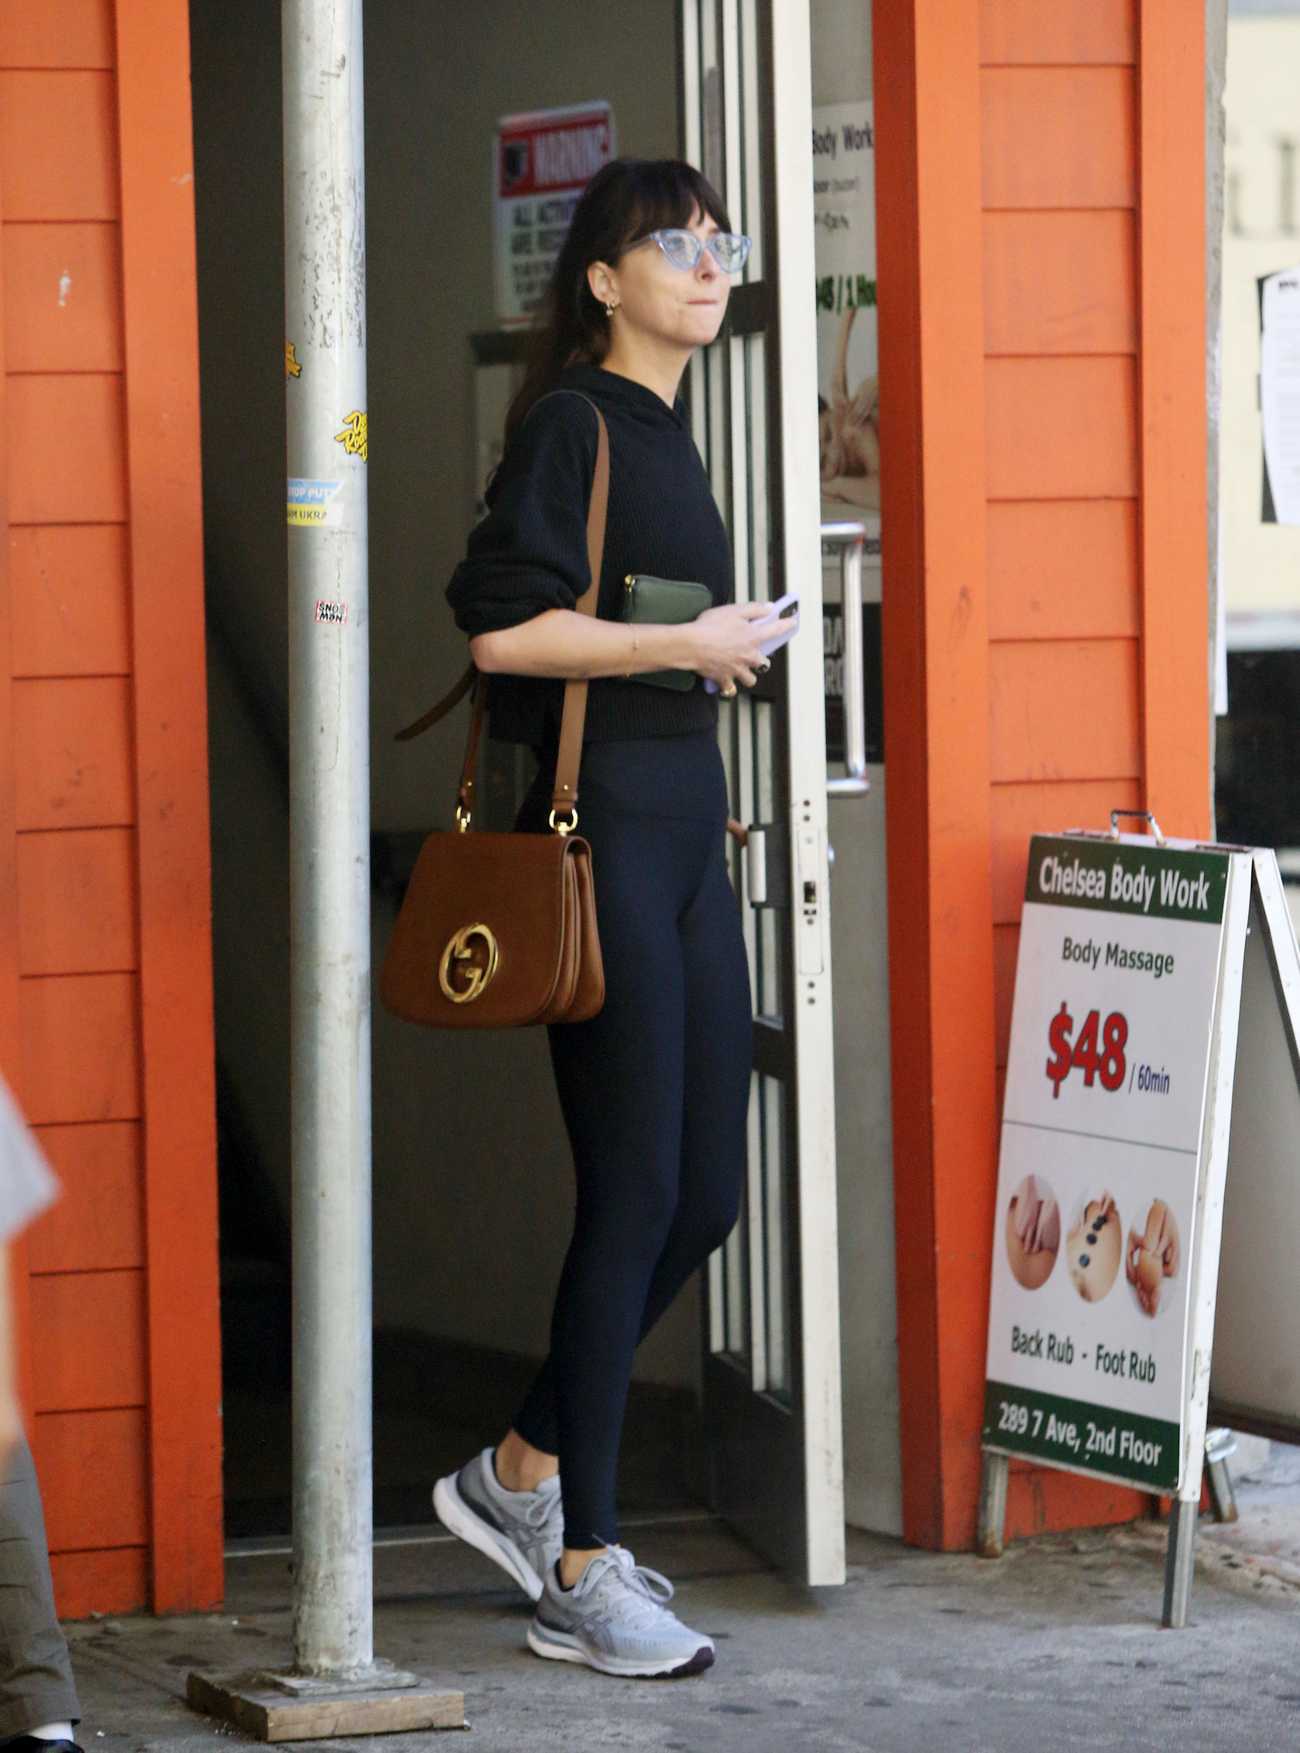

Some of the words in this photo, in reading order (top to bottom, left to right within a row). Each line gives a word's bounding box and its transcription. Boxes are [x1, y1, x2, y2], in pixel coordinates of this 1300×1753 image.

[842, 121, 874, 152] Work
[1039, 857, 1106, 899] Chelsea
[1110, 863, 1155, 913] Body
[1160, 869, 1211, 910] Work
[1062, 937, 1101, 970] Body
[1105, 942, 1175, 979] Massage
[1045, 1000, 1129, 1100] $48
[1011, 1325, 1043, 1359] Back
[1047, 1333, 1075, 1366] Rub
[1095, 1344, 1126, 1377] Foot
[1129, 1351, 1157, 1384] Rub
[998, 1401, 1029, 1434] 289
[1032, 1409, 1044, 1438] 7
[1045, 1413, 1081, 1452] Ave,
[1085, 1422, 1115, 1457] 2nd
[1119, 1430, 1163, 1468] Floor
